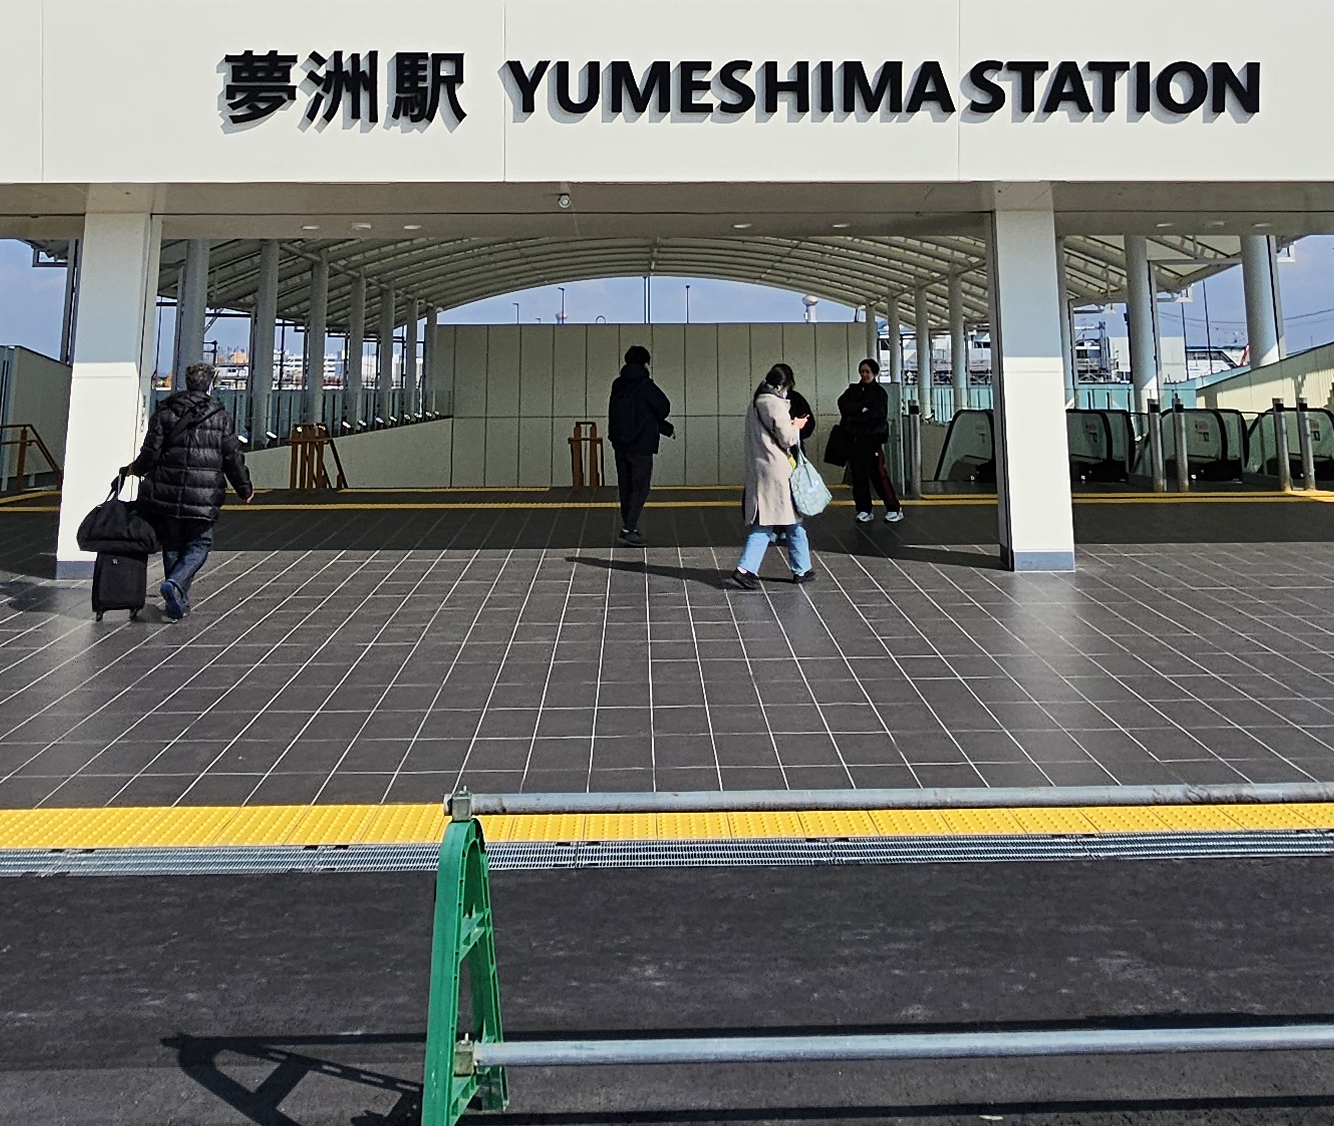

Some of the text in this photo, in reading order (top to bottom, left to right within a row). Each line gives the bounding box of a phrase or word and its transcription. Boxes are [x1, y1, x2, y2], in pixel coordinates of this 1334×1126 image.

[224, 50, 1261, 124] 夢洲駅 YUMESHIMA STATION
